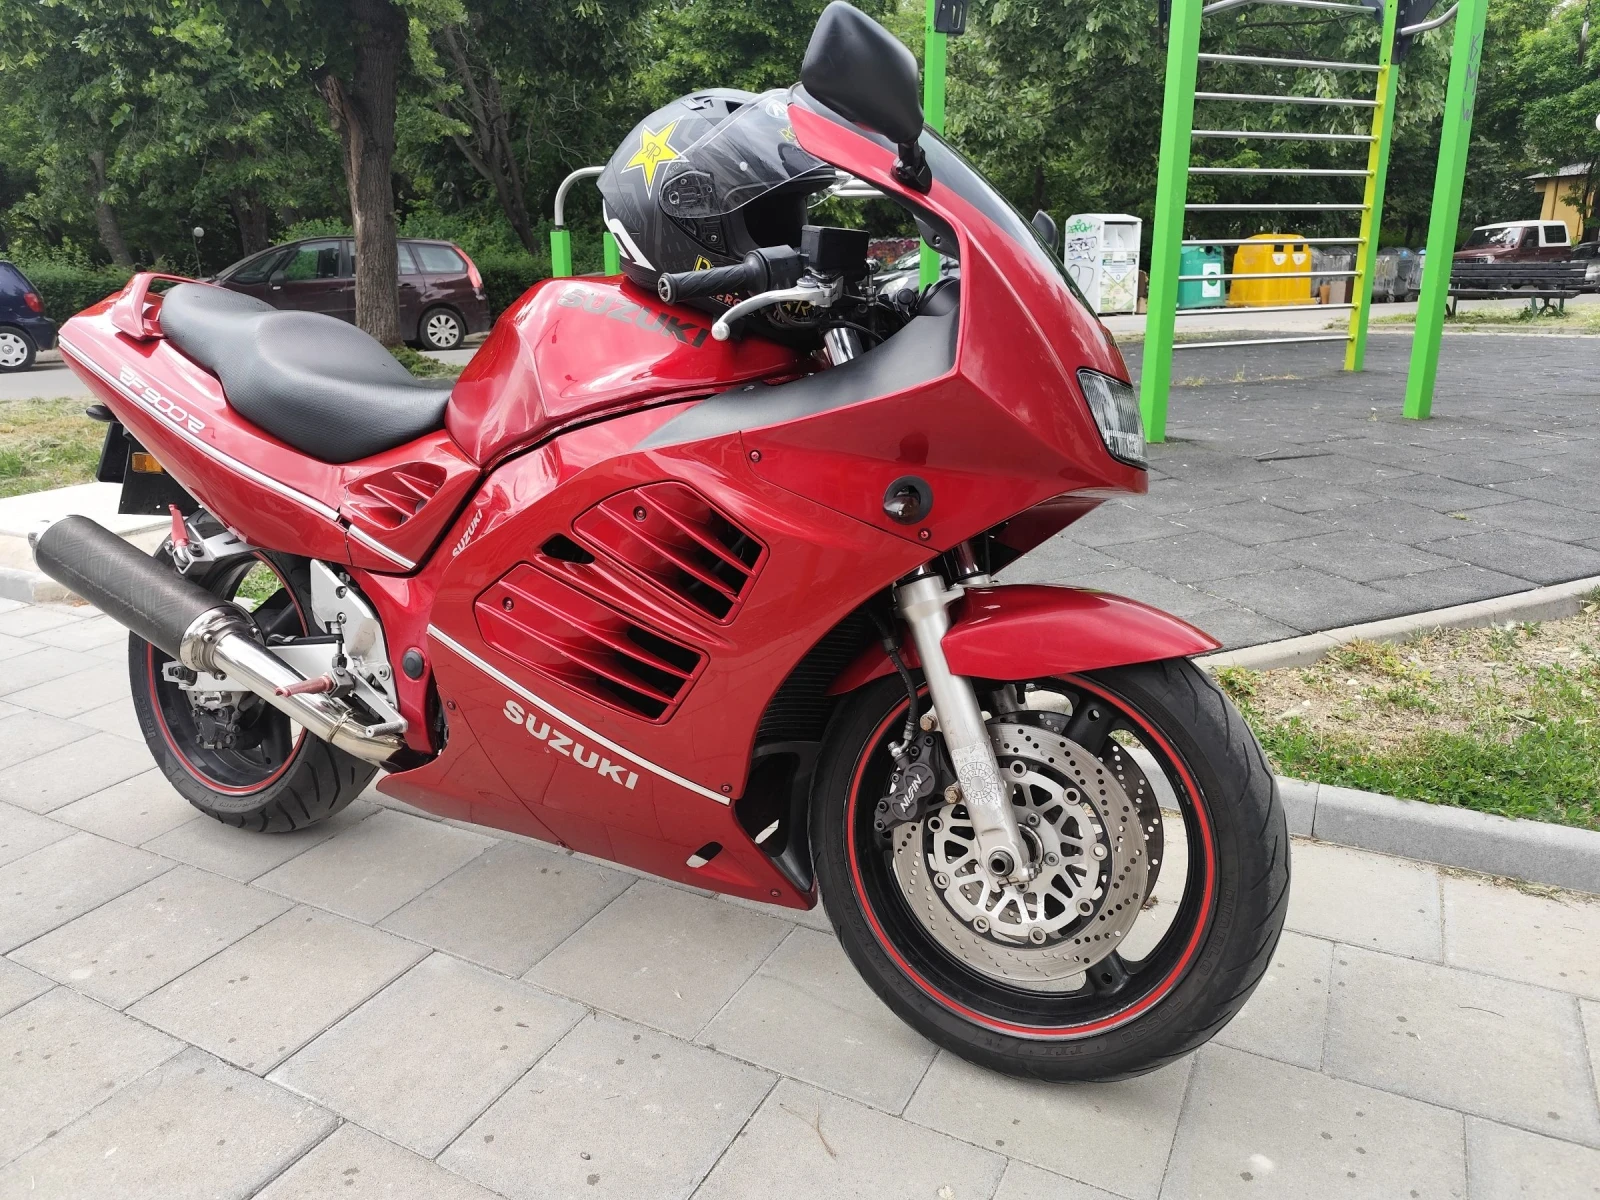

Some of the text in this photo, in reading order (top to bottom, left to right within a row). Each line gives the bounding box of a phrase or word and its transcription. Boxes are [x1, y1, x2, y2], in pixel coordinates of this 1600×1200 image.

[558, 288, 710, 349] SUZUKI
[453, 508, 483, 557] SUZUKI
[503, 699, 639, 790] SUZUKI
